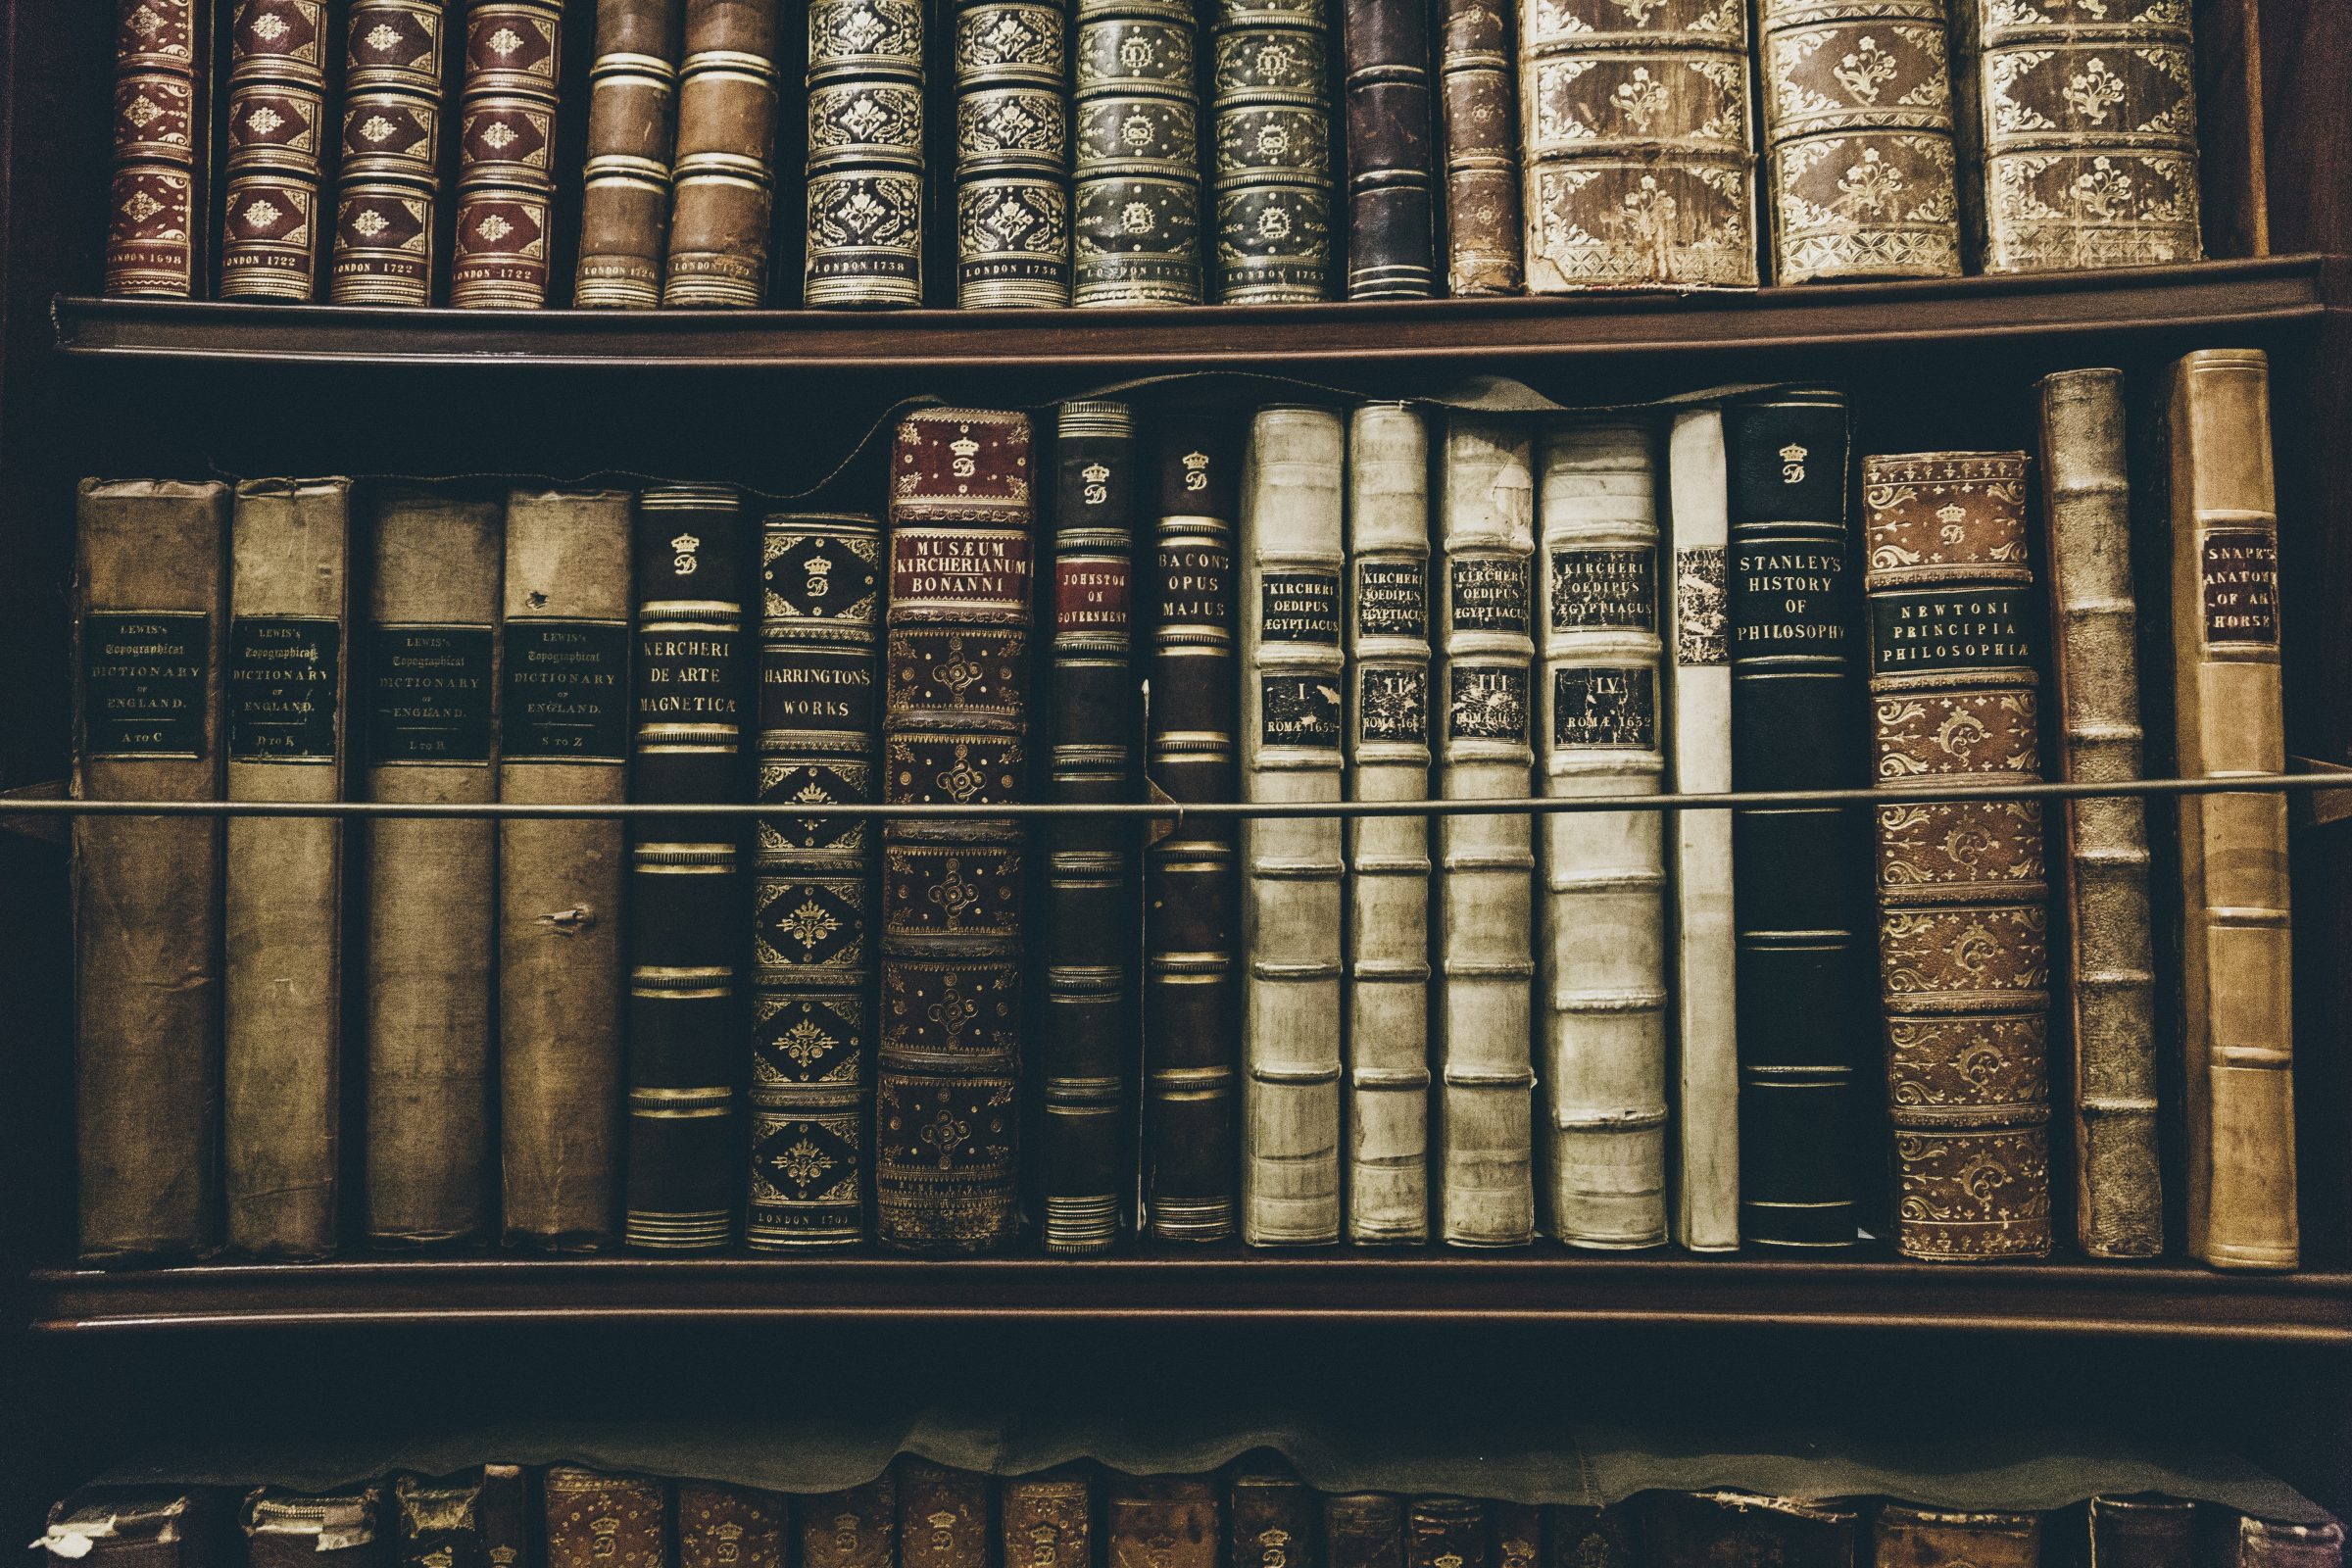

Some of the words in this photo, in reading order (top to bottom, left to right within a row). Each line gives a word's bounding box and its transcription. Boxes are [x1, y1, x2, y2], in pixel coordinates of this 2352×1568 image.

[149, 254, 181, 265] 1698
[267, 256, 296, 266] 1722
[675, 261, 716, 271] LONDON
[384, 264, 413, 273] 1722
[584, 266, 625, 275] LONDON
[815, 261, 866, 273] LONDON
[873, 261, 905, 271] 1738
[965, 265, 1017, 277] LONDON
[1026, 265, 1056, 275] 1738
[1088, 266, 1147, 277] LONDON
[501, 269, 532, 279] 1722
[1228, 270, 1285, 281] LONDON
[916, 541, 1004, 557] MUSÆUM
[897, 558, 1026, 575] KIRCHERIANUM
[1564, 563, 1643, 575] KIRCHERI
[1740, 555, 1841, 572] STANLEY'S
[911, 577, 1004, 593] BONANNI
[1063, 573, 1125, 587] JOHNSTON
[1168, 575, 1218, 592] OPUS
[1364, 573, 1423, 587] KIRCHERI
[1748, 576, 1832, 592] HISTORY
[1269, 583, 1334, 597] KIRCHERI
[1463, 588, 1519, 600] OEDIPUS
[1571, 581, 1640, 594] OEDIPUS
[1087, 591, 1103, 603] ON
[1370, 589, 1421, 602] OEDIPUS
[2217, 593, 2238, 605] OF
[2250, 593, 2269, 605] AN
[1162, 601, 1224, 616] MAJUS
[1274, 601, 1329, 613] OEDIPUS
[1556, 603, 1651, 616] ÆGYPTIACUS
[1785, 599, 1806, 613] OF
[1901, 602, 2008, 619] NEWTONI
[1058, 611, 1126, 624] GOVERNMENT
[1454, 608, 1528, 619] ÆGYPTIACUS
[1264, 618, 1339, 632] ÆGYPTIACUS
[2215, 615, 2270, 628] HORSE
[1737, 624, 1844, 641] PHILOSOPHY
[1892, 622, 2016, 639] PRINCIPIA
[105, 643, 184, 658] Topographical
[244, 645, 317, 660] Topographical
[644, 641, 729, 658] KERCHERI
[1883, 643, 2029, 662] PHILOSOPHIÆ
[392, 655, 466, 668] Topographical
[527, 651, 601, 663] Topographical
[92, 666, 201, 677] DICTIONARY
[232, 669, 329, 681] DICTIONARY
[651, 667, 669, 683] DE
[677, 667, 721, 683] ARTE
[764, 667, 870, 686] HARRINGTON'S
[379, 676, 479, 689] DICTIONARY
[514, 672, 616, 686] DICTIONARY
[1479, 674, 1508, 691] III
[1298, 683, 1305, 700] I
[1384, 677, 1404, 695] II
[107, 697, 187, 709] ENGLAND.
[244, 700, 316, 713] ENGLAND.
[526, 703, 602, 715] ENGLAND.
[783, 700, 850, 716] WORKS
[393, 708, 467, 718] ENGLAND.
[1267, 720, 1303, 732] ROMÆ
[1568, 716, 1611, 728] ROMÆ
[1619, 716, 1651, 728] 1652
[122, 733, 131, 743] A
[153, 732, 163, 743] C
[257, 735, 267, 746] D
[542, 736, 549, 747] S
[573, 737, 583, 747] Z
[409, 740, 416, 751] L
